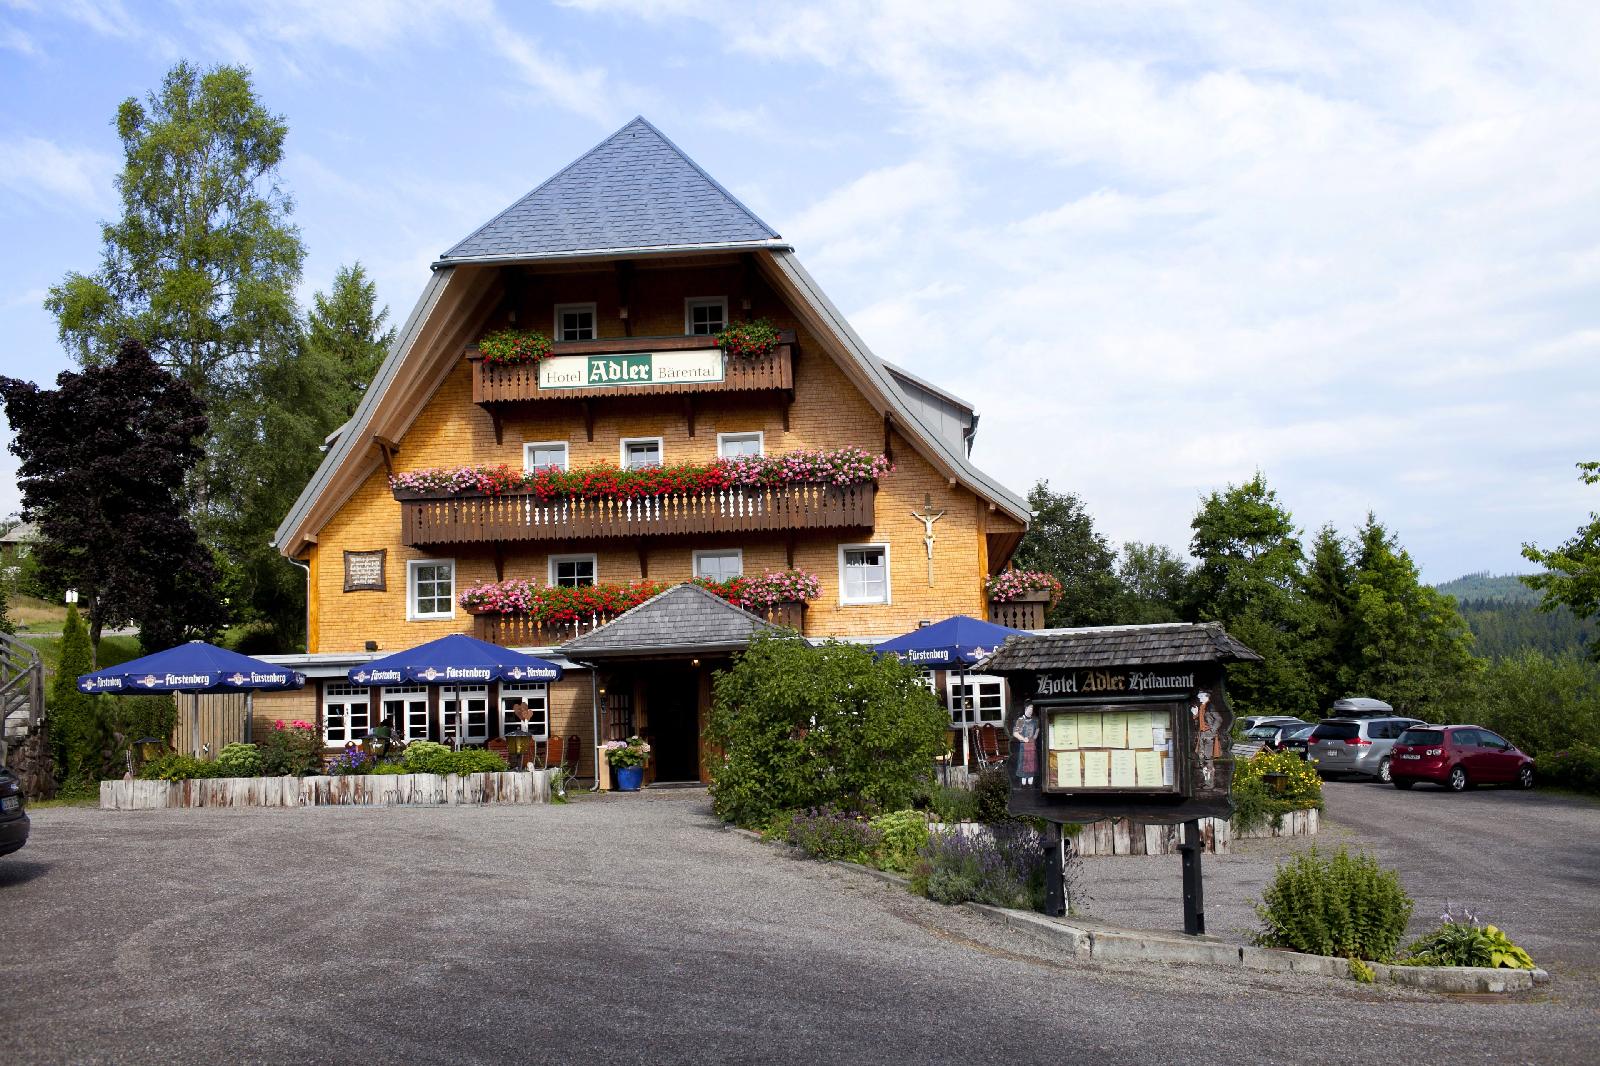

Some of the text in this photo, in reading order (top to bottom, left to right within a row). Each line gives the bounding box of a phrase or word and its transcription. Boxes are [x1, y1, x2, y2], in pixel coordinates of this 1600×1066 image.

[547, 360, 715, 384] Hotel Adler Bärental
[165, 673, 210, 686] Fürstenberg
[446, 666, 491, 680] Fürstenberg
[1036, 673, 1078, 694] Hotel
[1081, 670, 1126, 692] Adler
